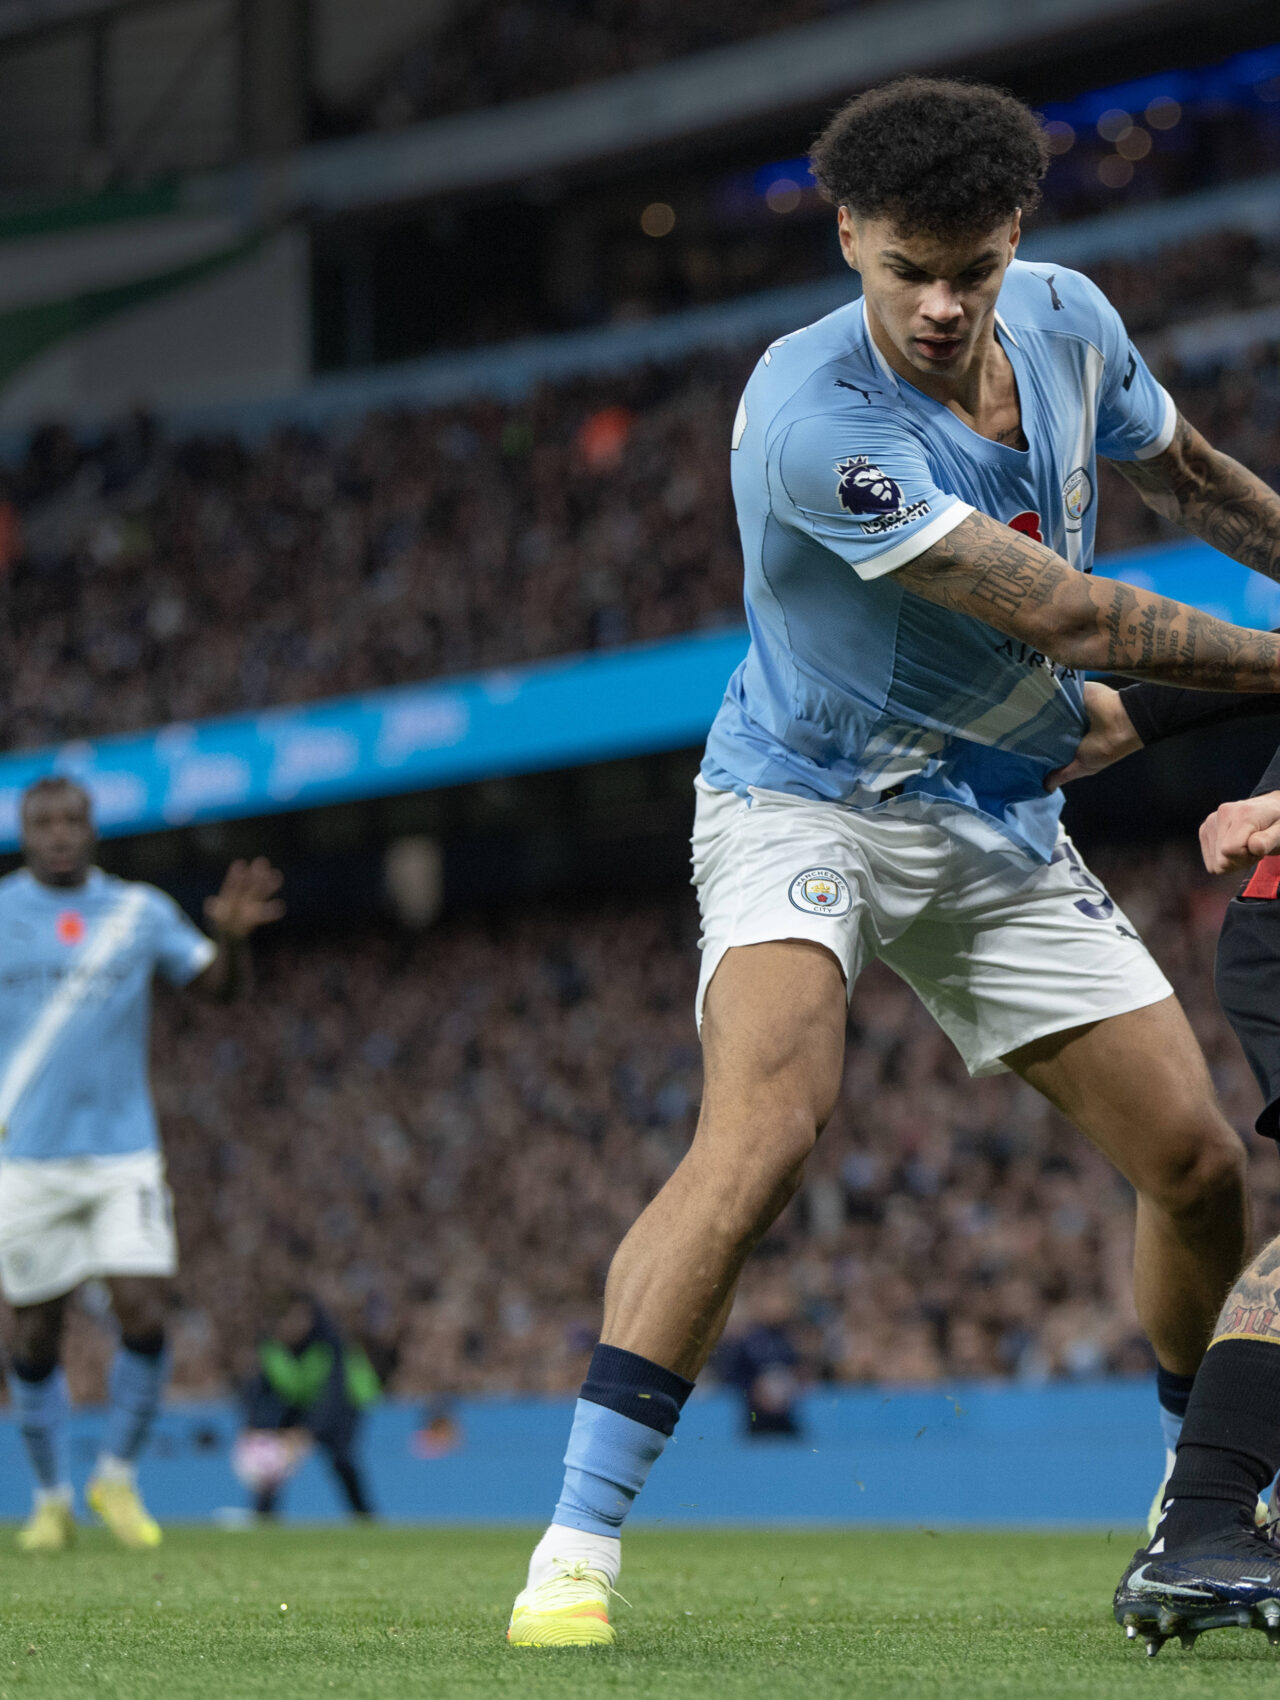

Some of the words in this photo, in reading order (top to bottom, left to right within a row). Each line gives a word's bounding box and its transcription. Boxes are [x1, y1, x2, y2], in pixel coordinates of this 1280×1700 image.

[972, 536, 1004, 570] STAY
[1028, 565, 1064, 604] HARD
[994, 639, 1078, 681] AIRA
[795, 870, 846, 891] MANCHESTER
[813, 906, 833, 914] CITY
